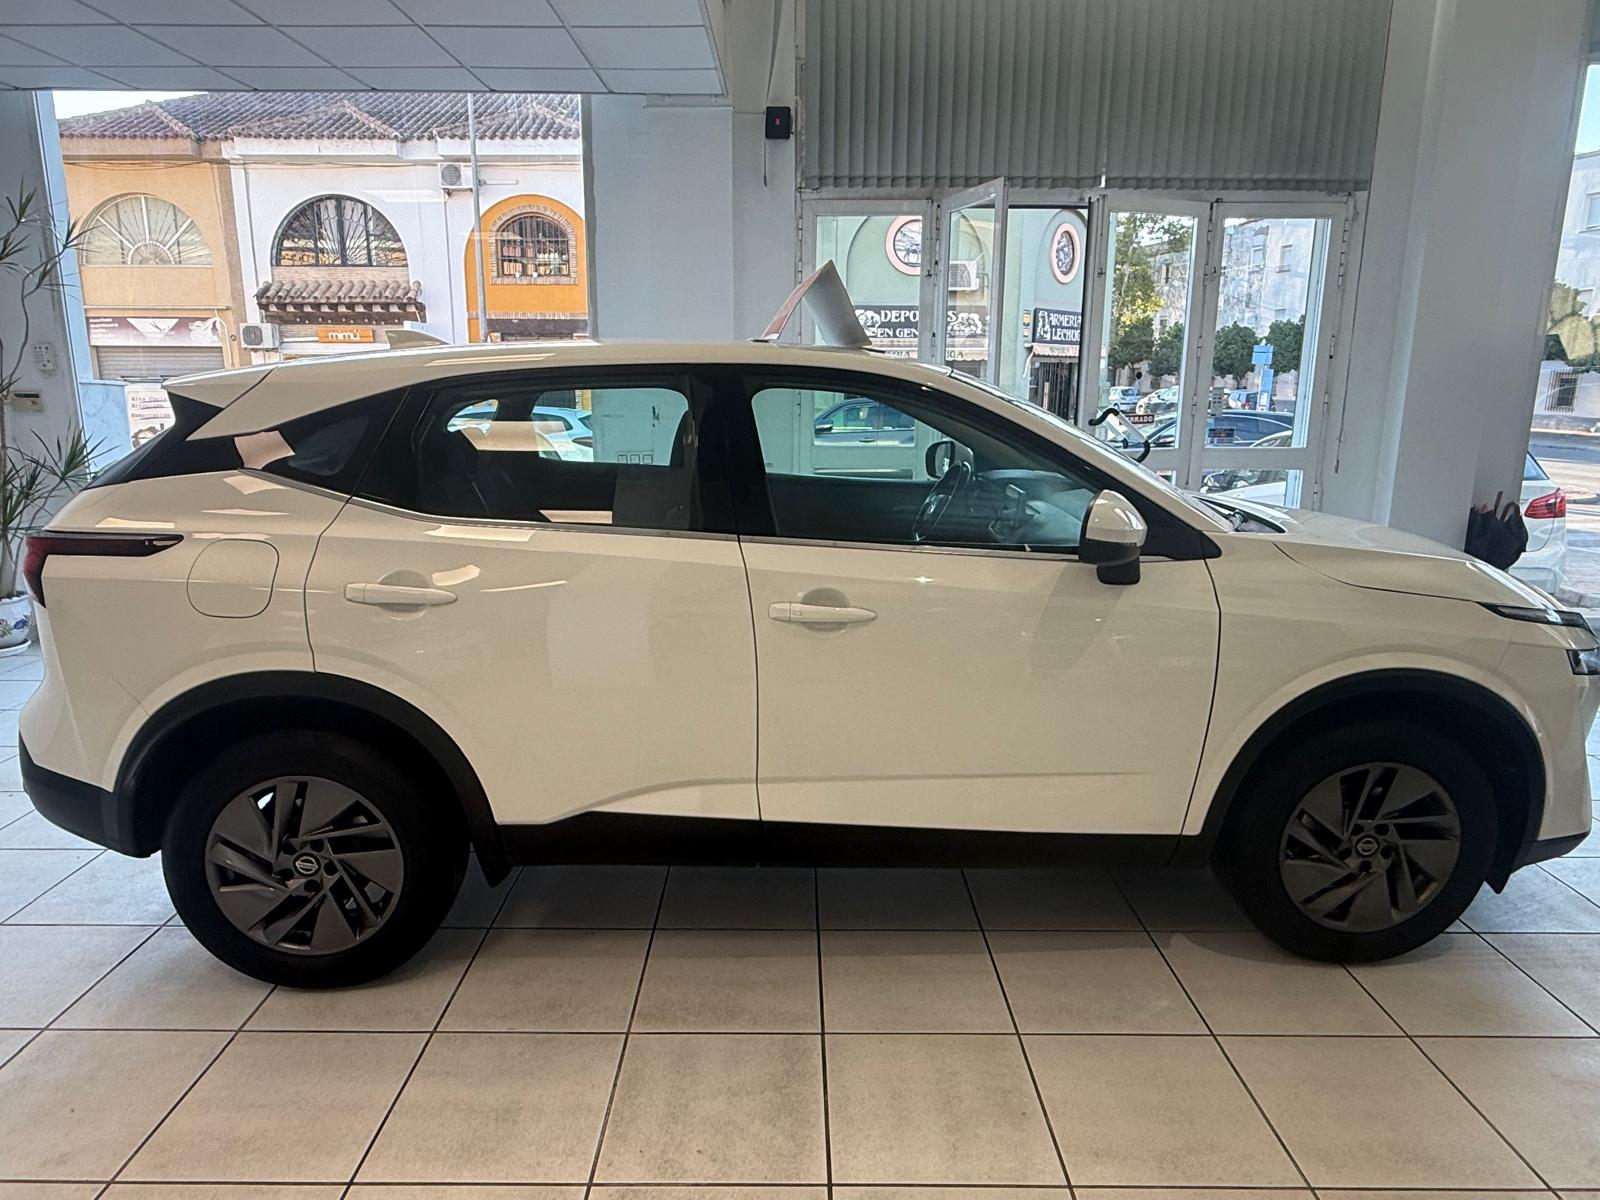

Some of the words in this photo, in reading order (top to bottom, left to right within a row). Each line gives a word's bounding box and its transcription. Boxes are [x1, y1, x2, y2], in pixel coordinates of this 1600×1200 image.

[877, 328, 893, 338] EN
[896, 328, 919, 338] GEN
[1052, 328, 1080, 341] LECHUG
